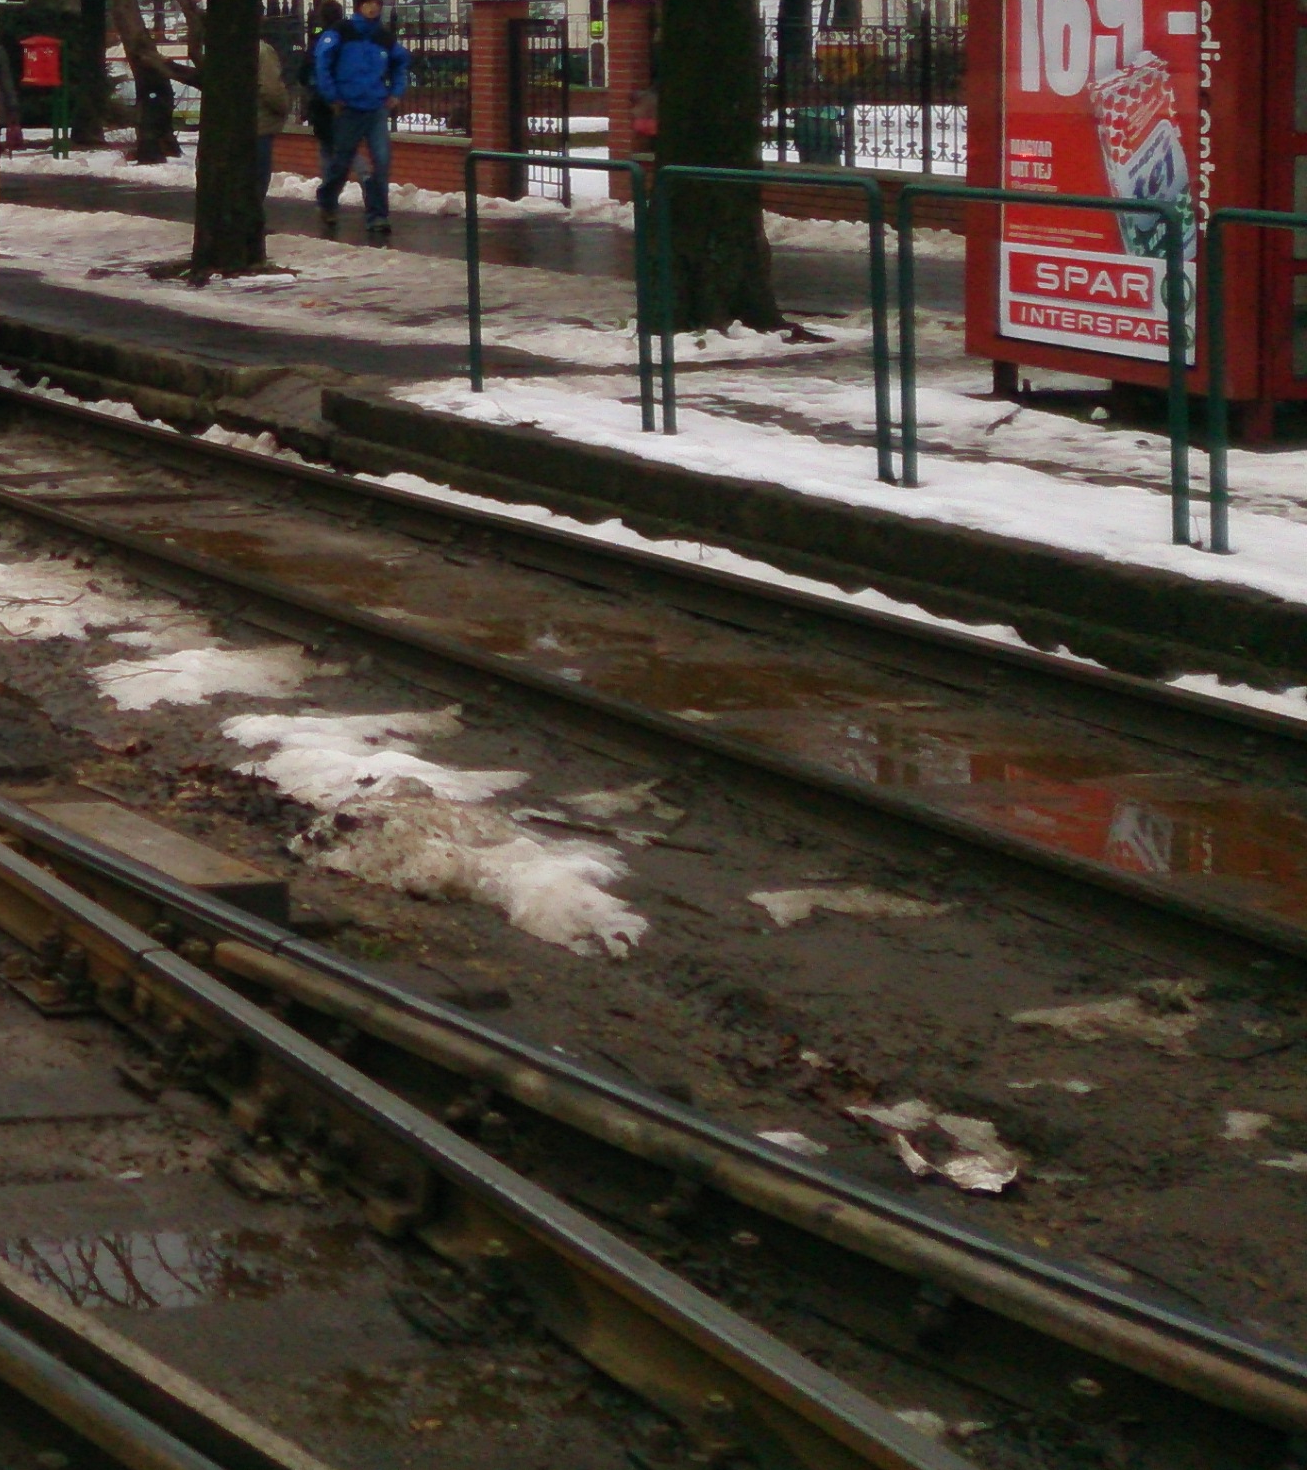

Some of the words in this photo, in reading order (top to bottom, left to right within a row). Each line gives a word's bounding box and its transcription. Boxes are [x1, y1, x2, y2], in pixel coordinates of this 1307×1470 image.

[1032, 162, 1052, 180] TEJ
[1037, 263, 1149, 302] SPAR
[1021, 306, 1169, 341] INTERSPAR
